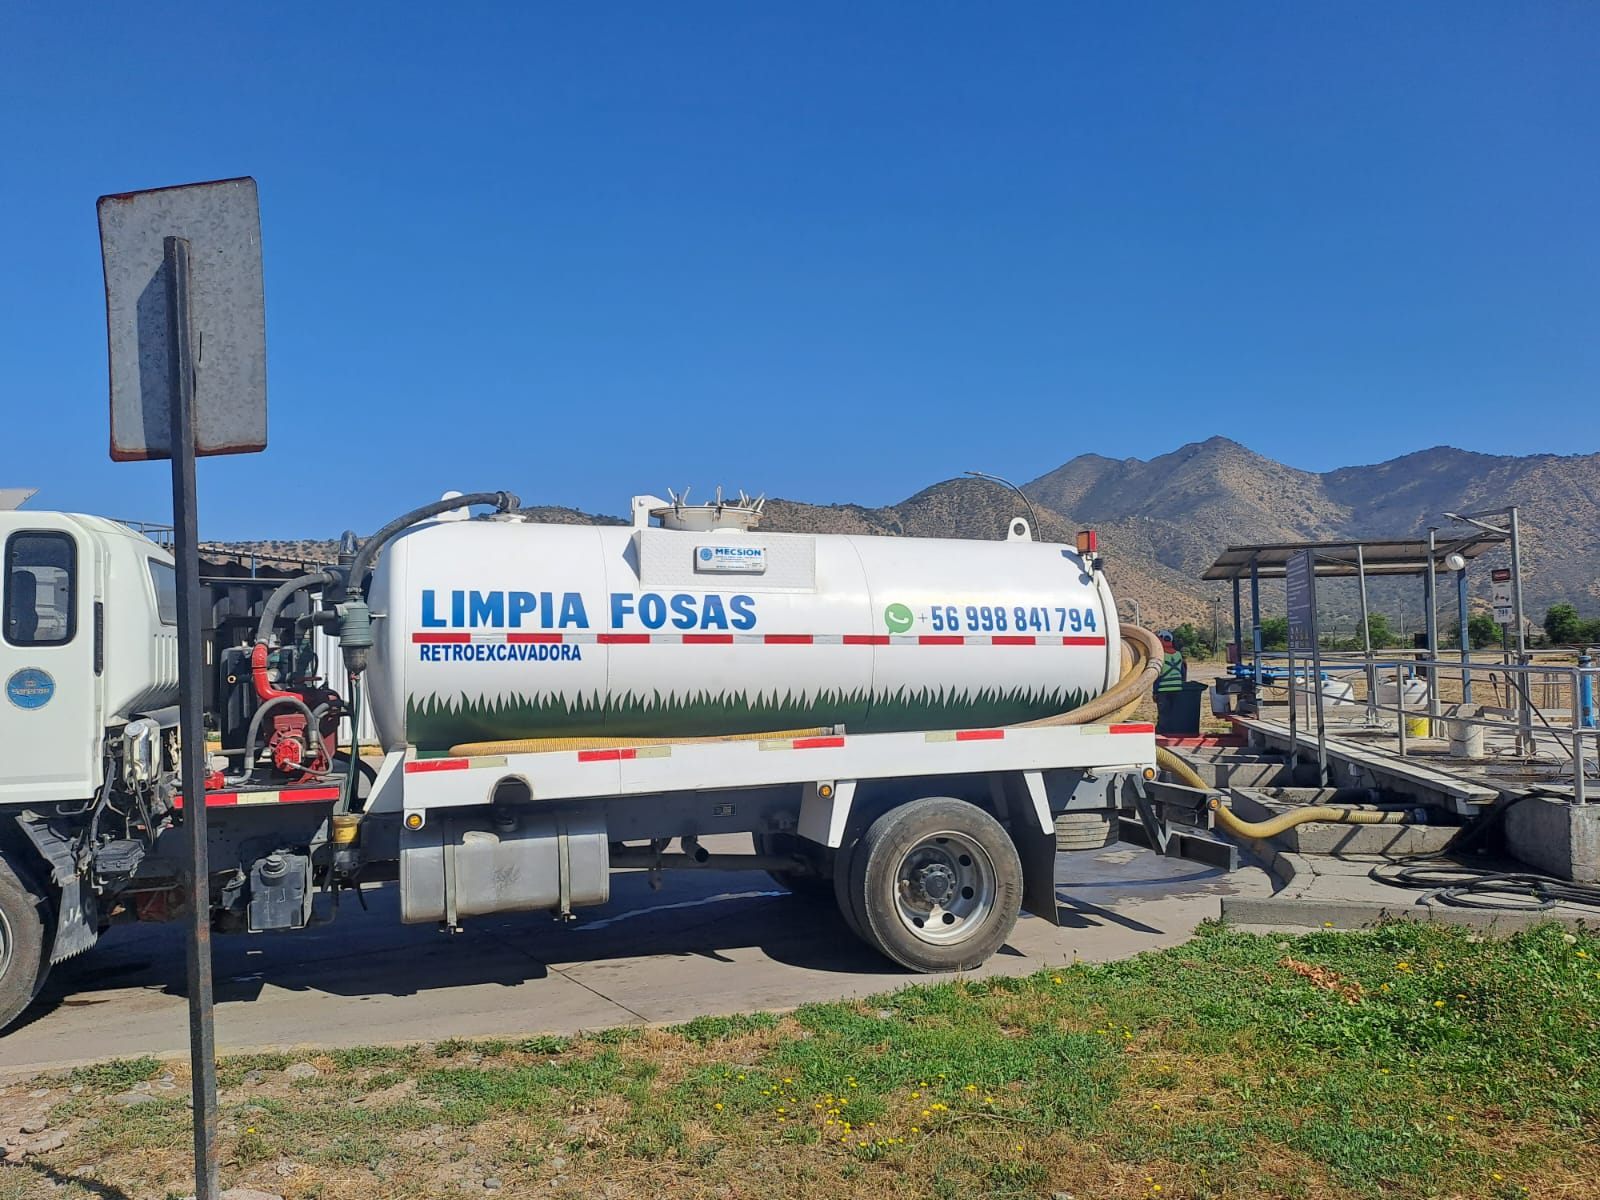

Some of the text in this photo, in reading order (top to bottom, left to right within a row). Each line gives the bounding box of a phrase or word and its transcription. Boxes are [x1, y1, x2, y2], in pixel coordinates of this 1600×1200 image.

[715, 548, 762, 556] MECSION
[421, 589, 757, 631] LIMPIA FOSAS
[966, 606, 1009, 632] 998
[1013, 607, 1051, 633] 841
[1056, 607, 1097, 633] 794
[420, 644, 582, 662] RETROEXCAVADORA
